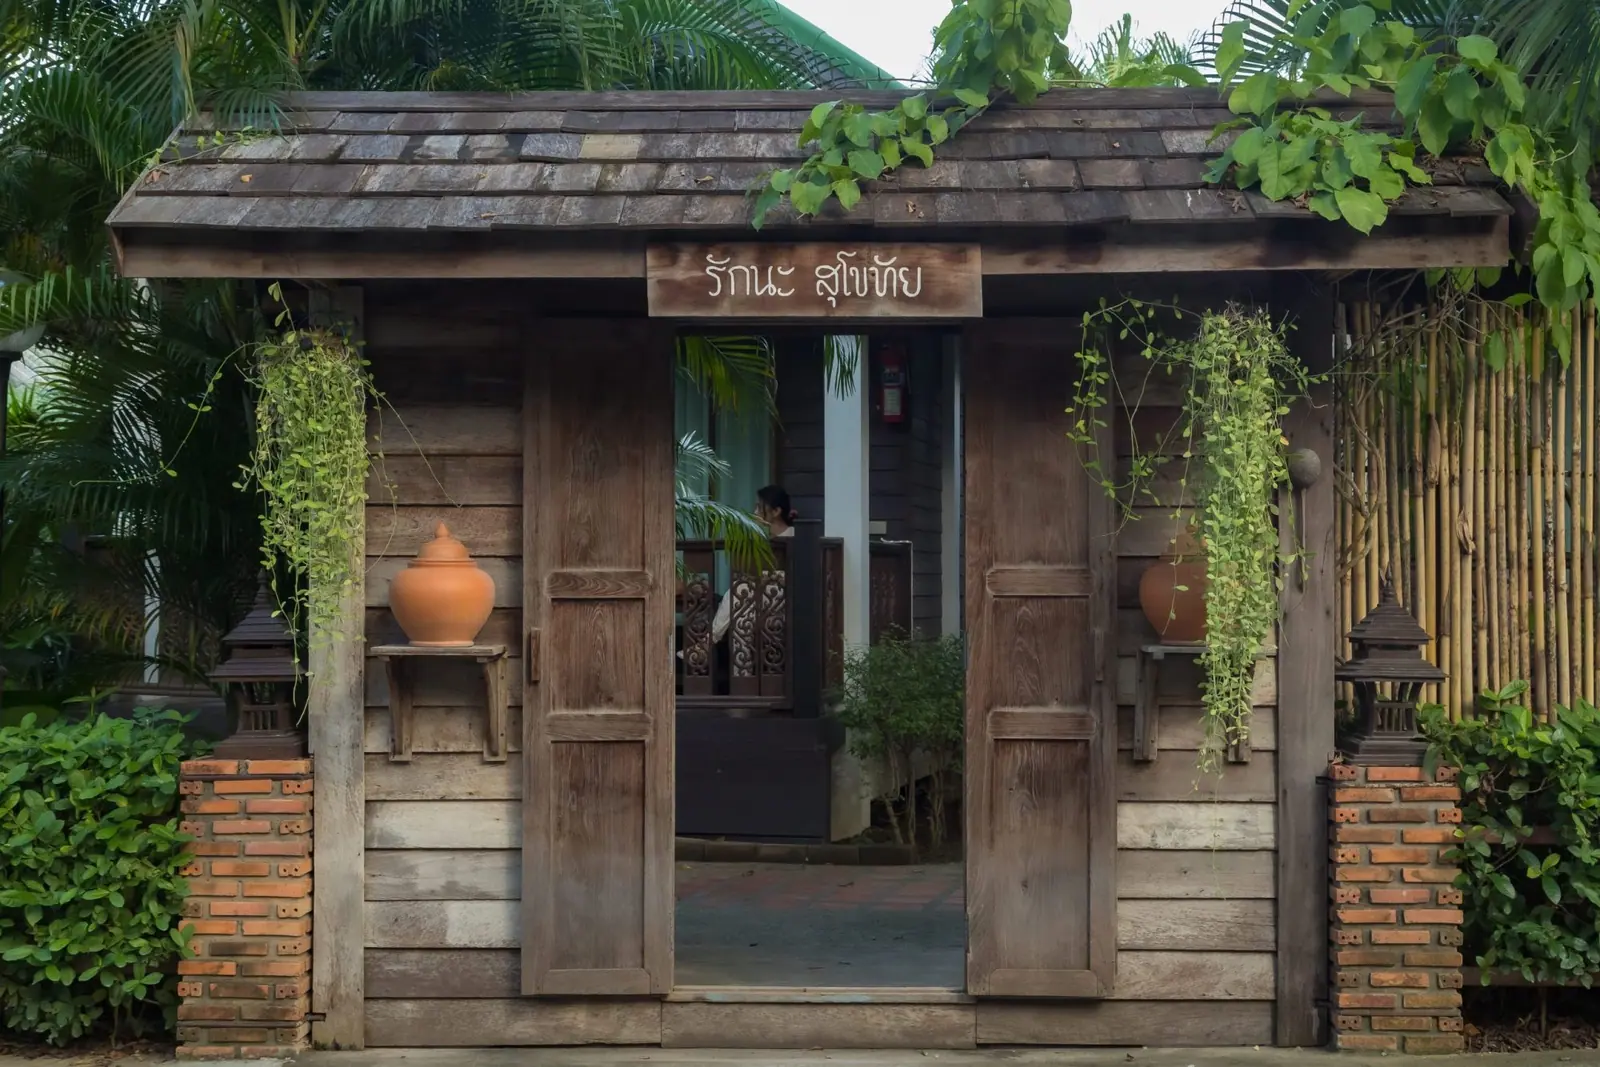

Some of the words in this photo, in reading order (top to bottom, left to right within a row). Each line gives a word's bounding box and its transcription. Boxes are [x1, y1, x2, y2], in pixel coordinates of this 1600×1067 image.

[705, 254, 795, 297] รักนะ
[814, 250, 922, 308] สุโขทัย
